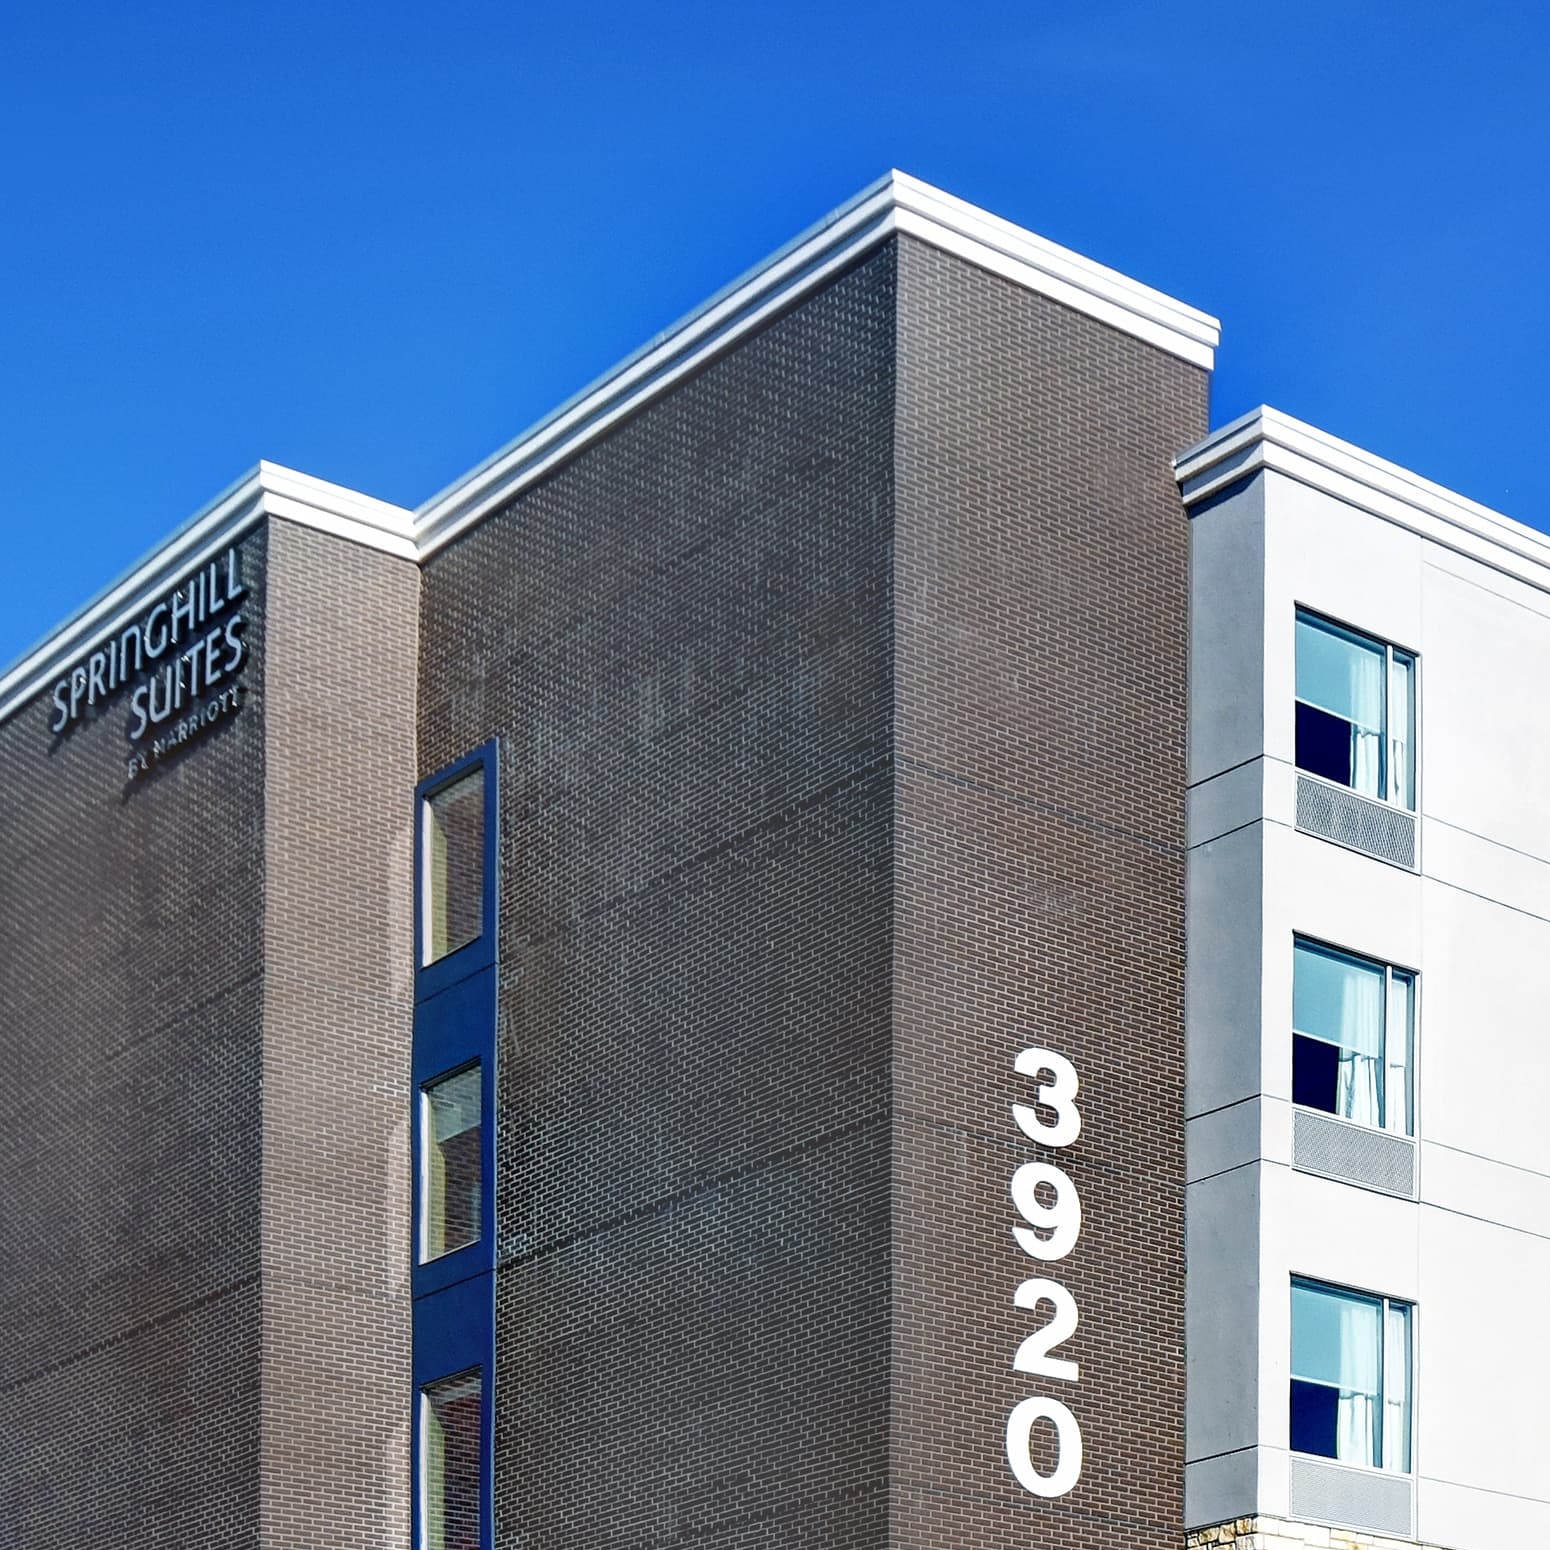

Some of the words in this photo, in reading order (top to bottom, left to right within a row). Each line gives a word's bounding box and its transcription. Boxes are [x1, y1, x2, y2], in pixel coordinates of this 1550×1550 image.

[52, 548, 243, 733] SPRINGHILL
[130, 614, 242, 740] SUITES
[1006, 1047, 1082, 1498] 3920
